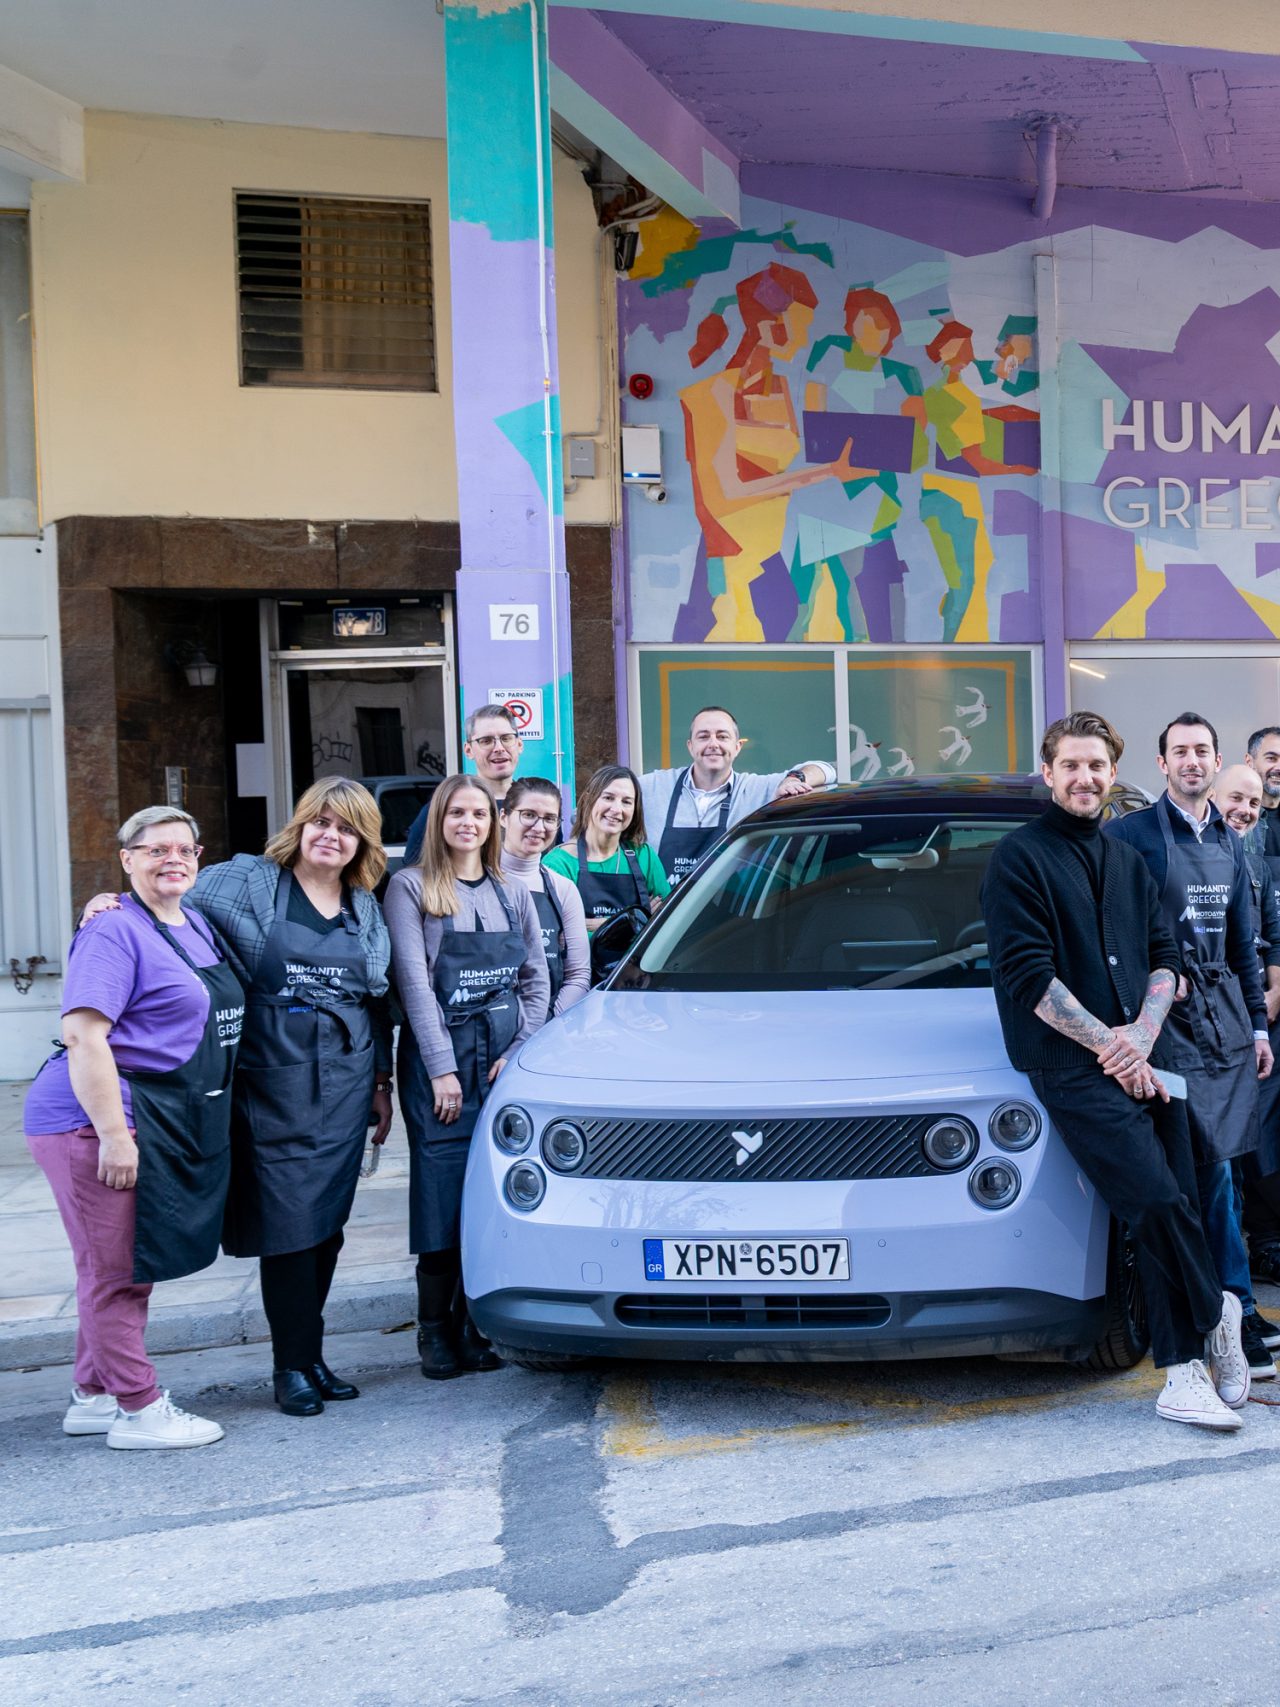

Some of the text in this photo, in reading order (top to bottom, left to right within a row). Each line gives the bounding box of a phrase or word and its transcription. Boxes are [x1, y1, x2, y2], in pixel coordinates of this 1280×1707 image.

[499, 613, 530, 634] 76
[1187, 884, 1229, 893] HUMANITY
[1188, 895, 1222, 904] GREECE
[286, 964, 344, 977] HUMANITY
[459, 966, 515, 979] HUMANITY
[459, 976, 501, 987] GREECE
[647, 1243, 842, 1276] GR XPN-6507
